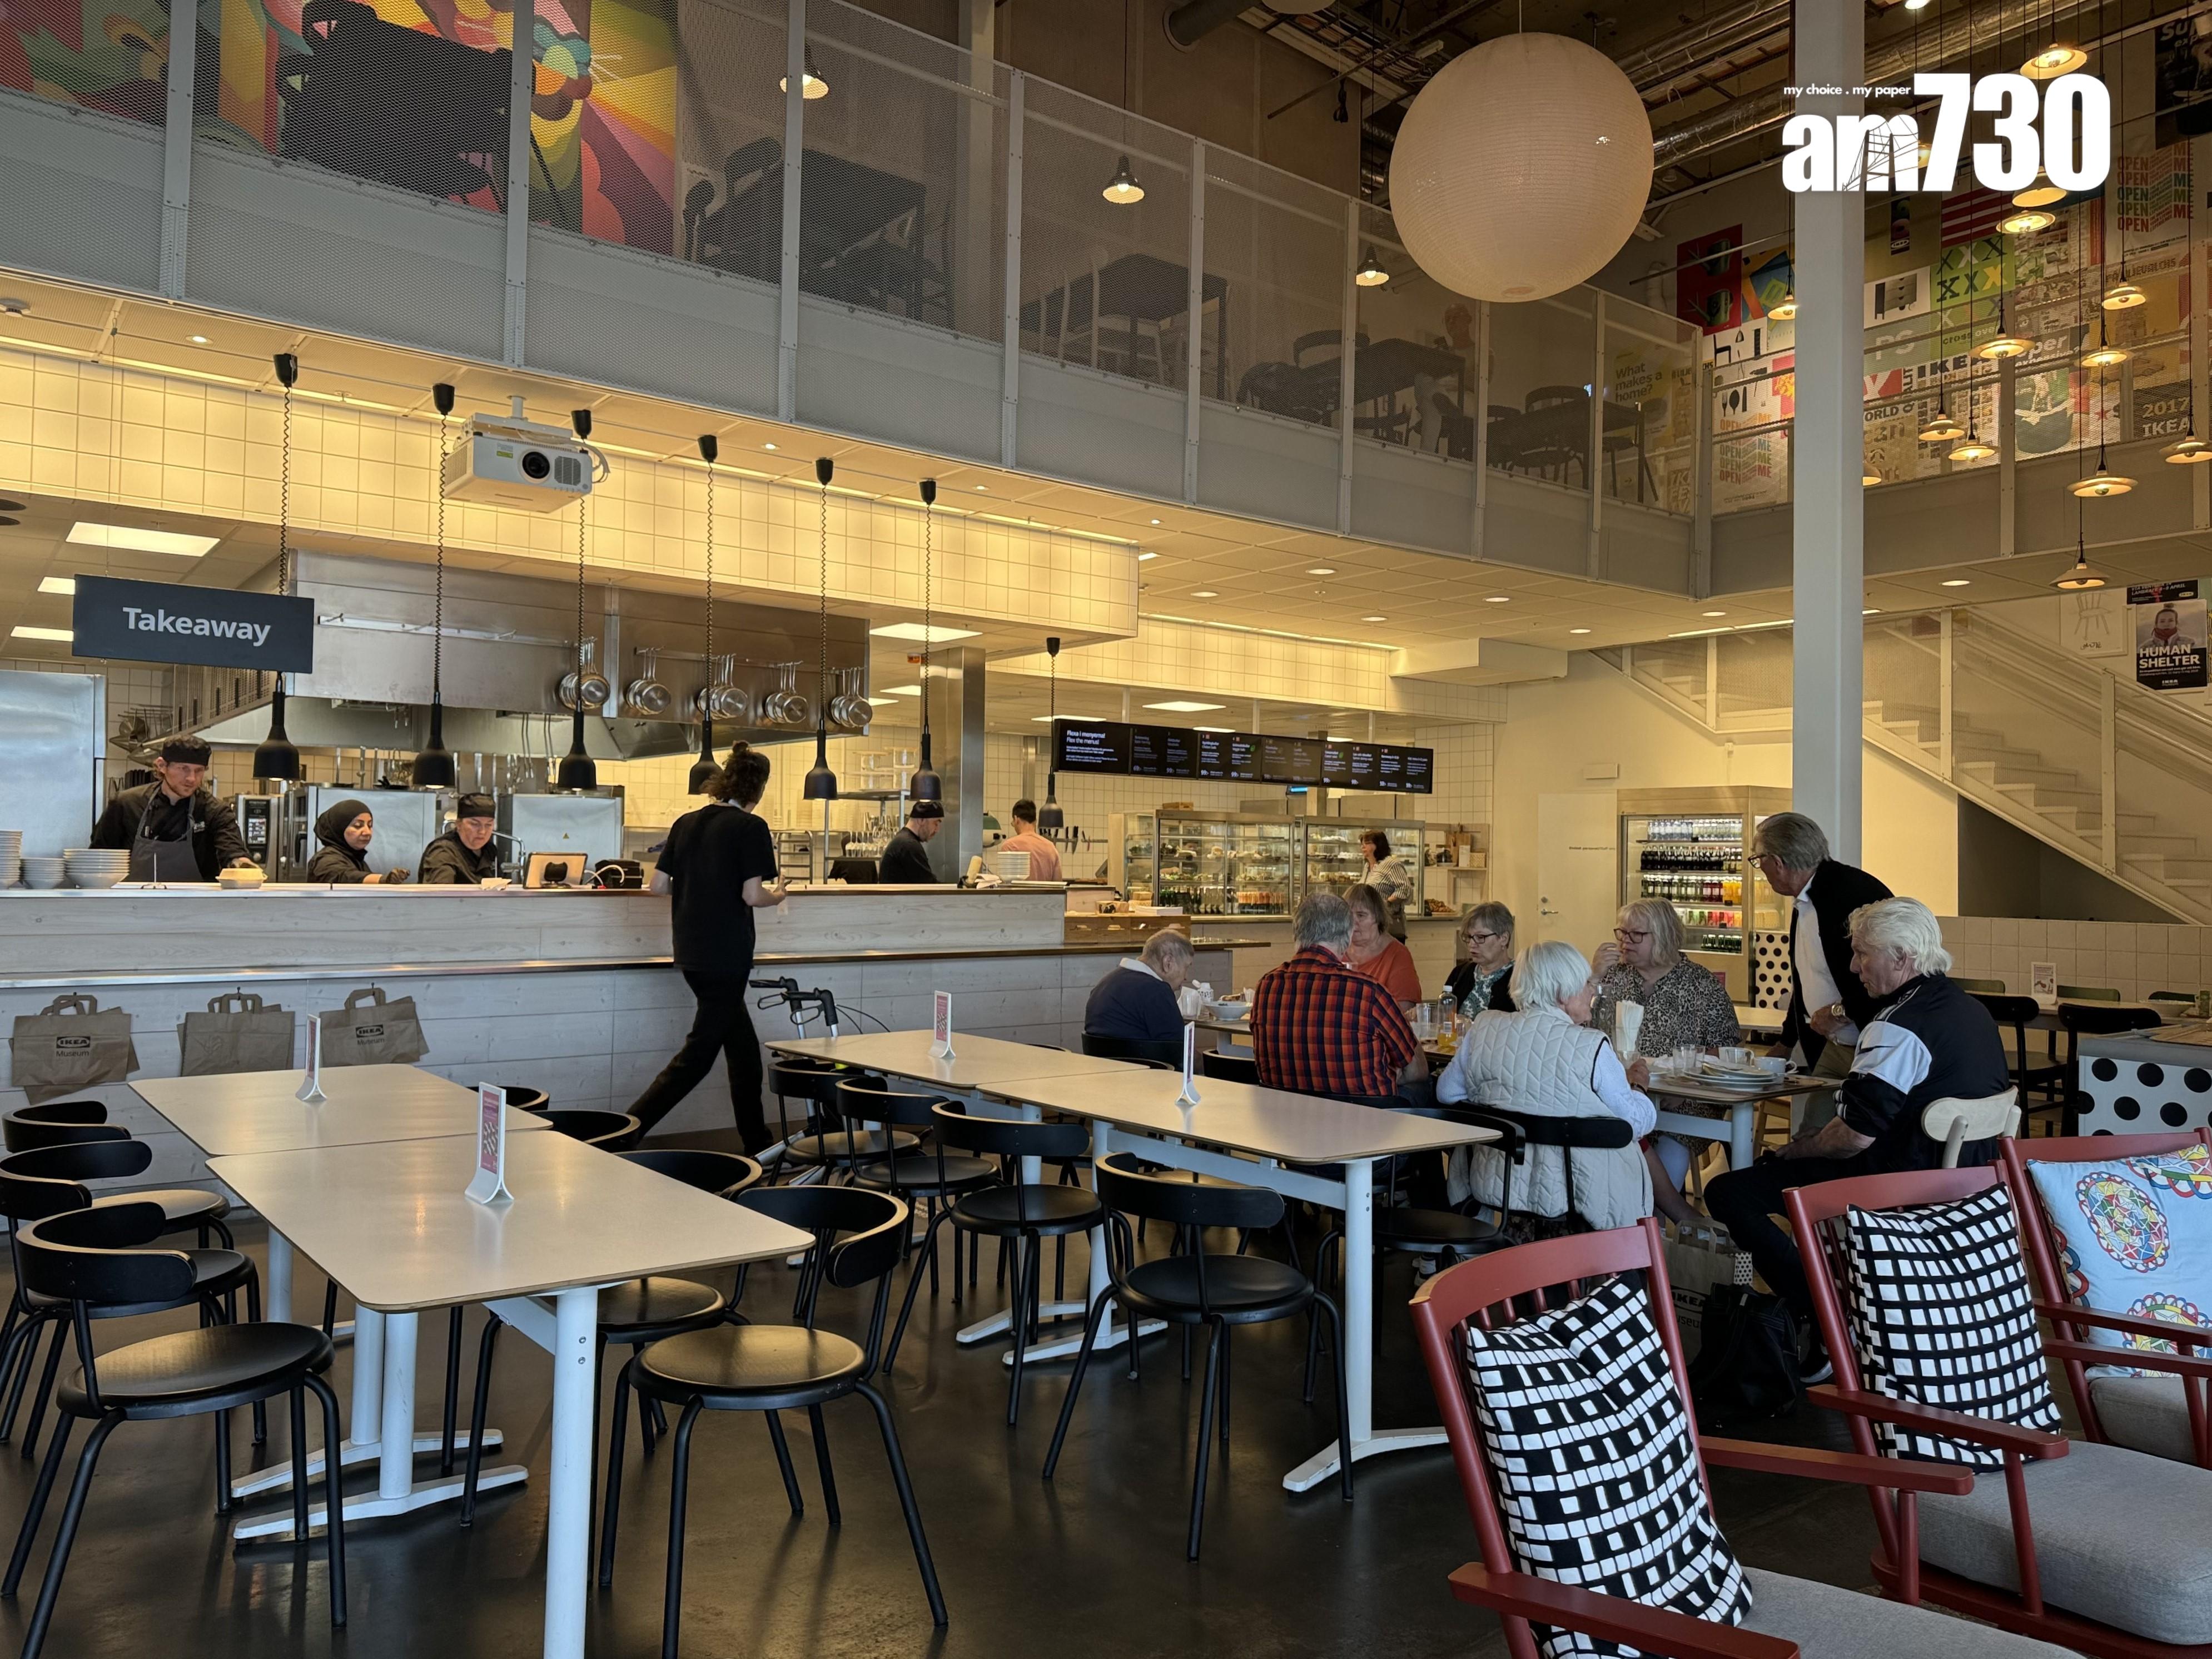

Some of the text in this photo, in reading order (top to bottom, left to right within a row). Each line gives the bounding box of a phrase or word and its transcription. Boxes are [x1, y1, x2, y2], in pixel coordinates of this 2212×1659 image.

[2117, 156, 2149, 171] OPEN
[2117, 171, 2149, 186] OPEN
[2117, 186, 2149, 201] OPEN
[2117, 202, 2149, 217] OPEN
[2117, 217, 2149, 232] OPEN
[1615, 362, 1646, 379] What
[1615, 374, 1653, 391] makes
[1655, 371, 1662, 381] a
[1615, 384, 1653, 403] home?
[1865, 405, 1899, 422] ORLD
[2143, 396, 2190, 418] 2017
[2143, 416, 2190, 438] IKEA
[1720, 470, 1741, 485] OPEN
[122, 607, 271, 647] Takeaway
[2139, 644, 2191, 658] HUMAN
[2139, 654, 2200, 669] SHELTER
